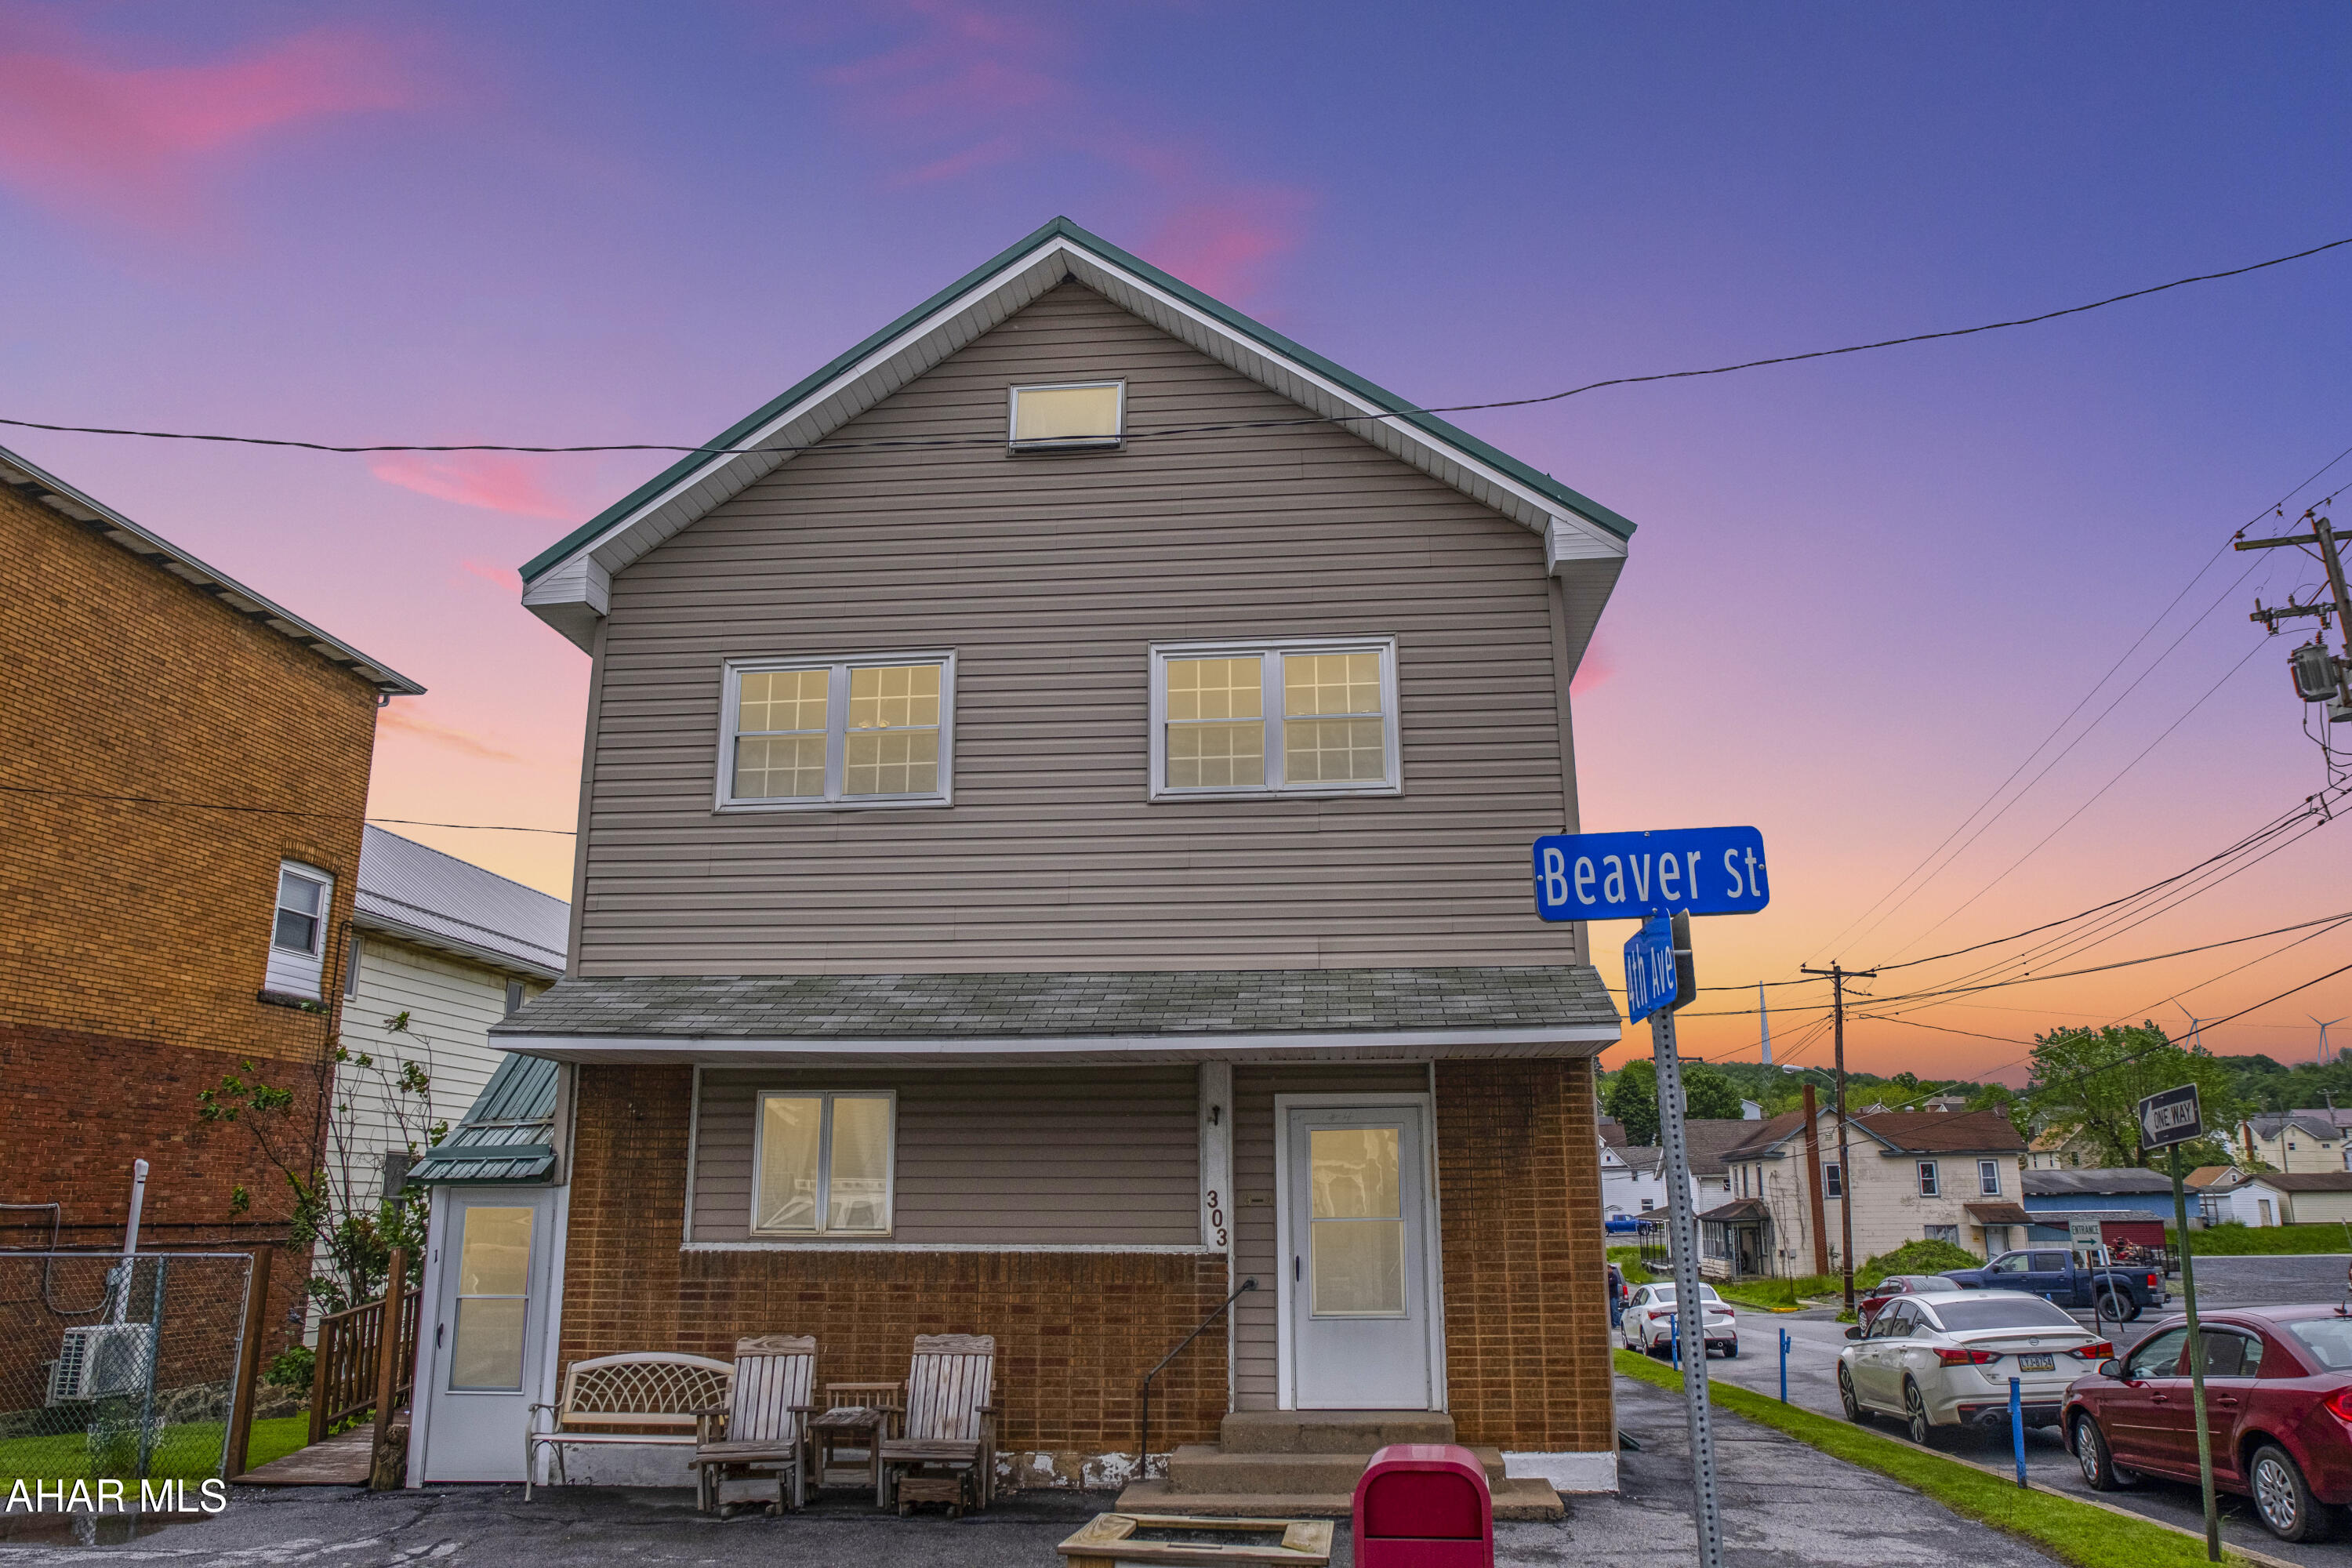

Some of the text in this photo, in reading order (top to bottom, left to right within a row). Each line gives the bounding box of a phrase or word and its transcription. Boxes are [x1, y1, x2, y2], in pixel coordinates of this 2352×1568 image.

[1543, 847, 1761, 906] Beaver St
[1628, 943, 1674, 1012] 4th Ave
[2154, 1102, 2191, 1130] ONE WAY
[1207, 1189, 1228, 1247] 303
[2071, 1225, 2100, 1235] ENTRANCE
